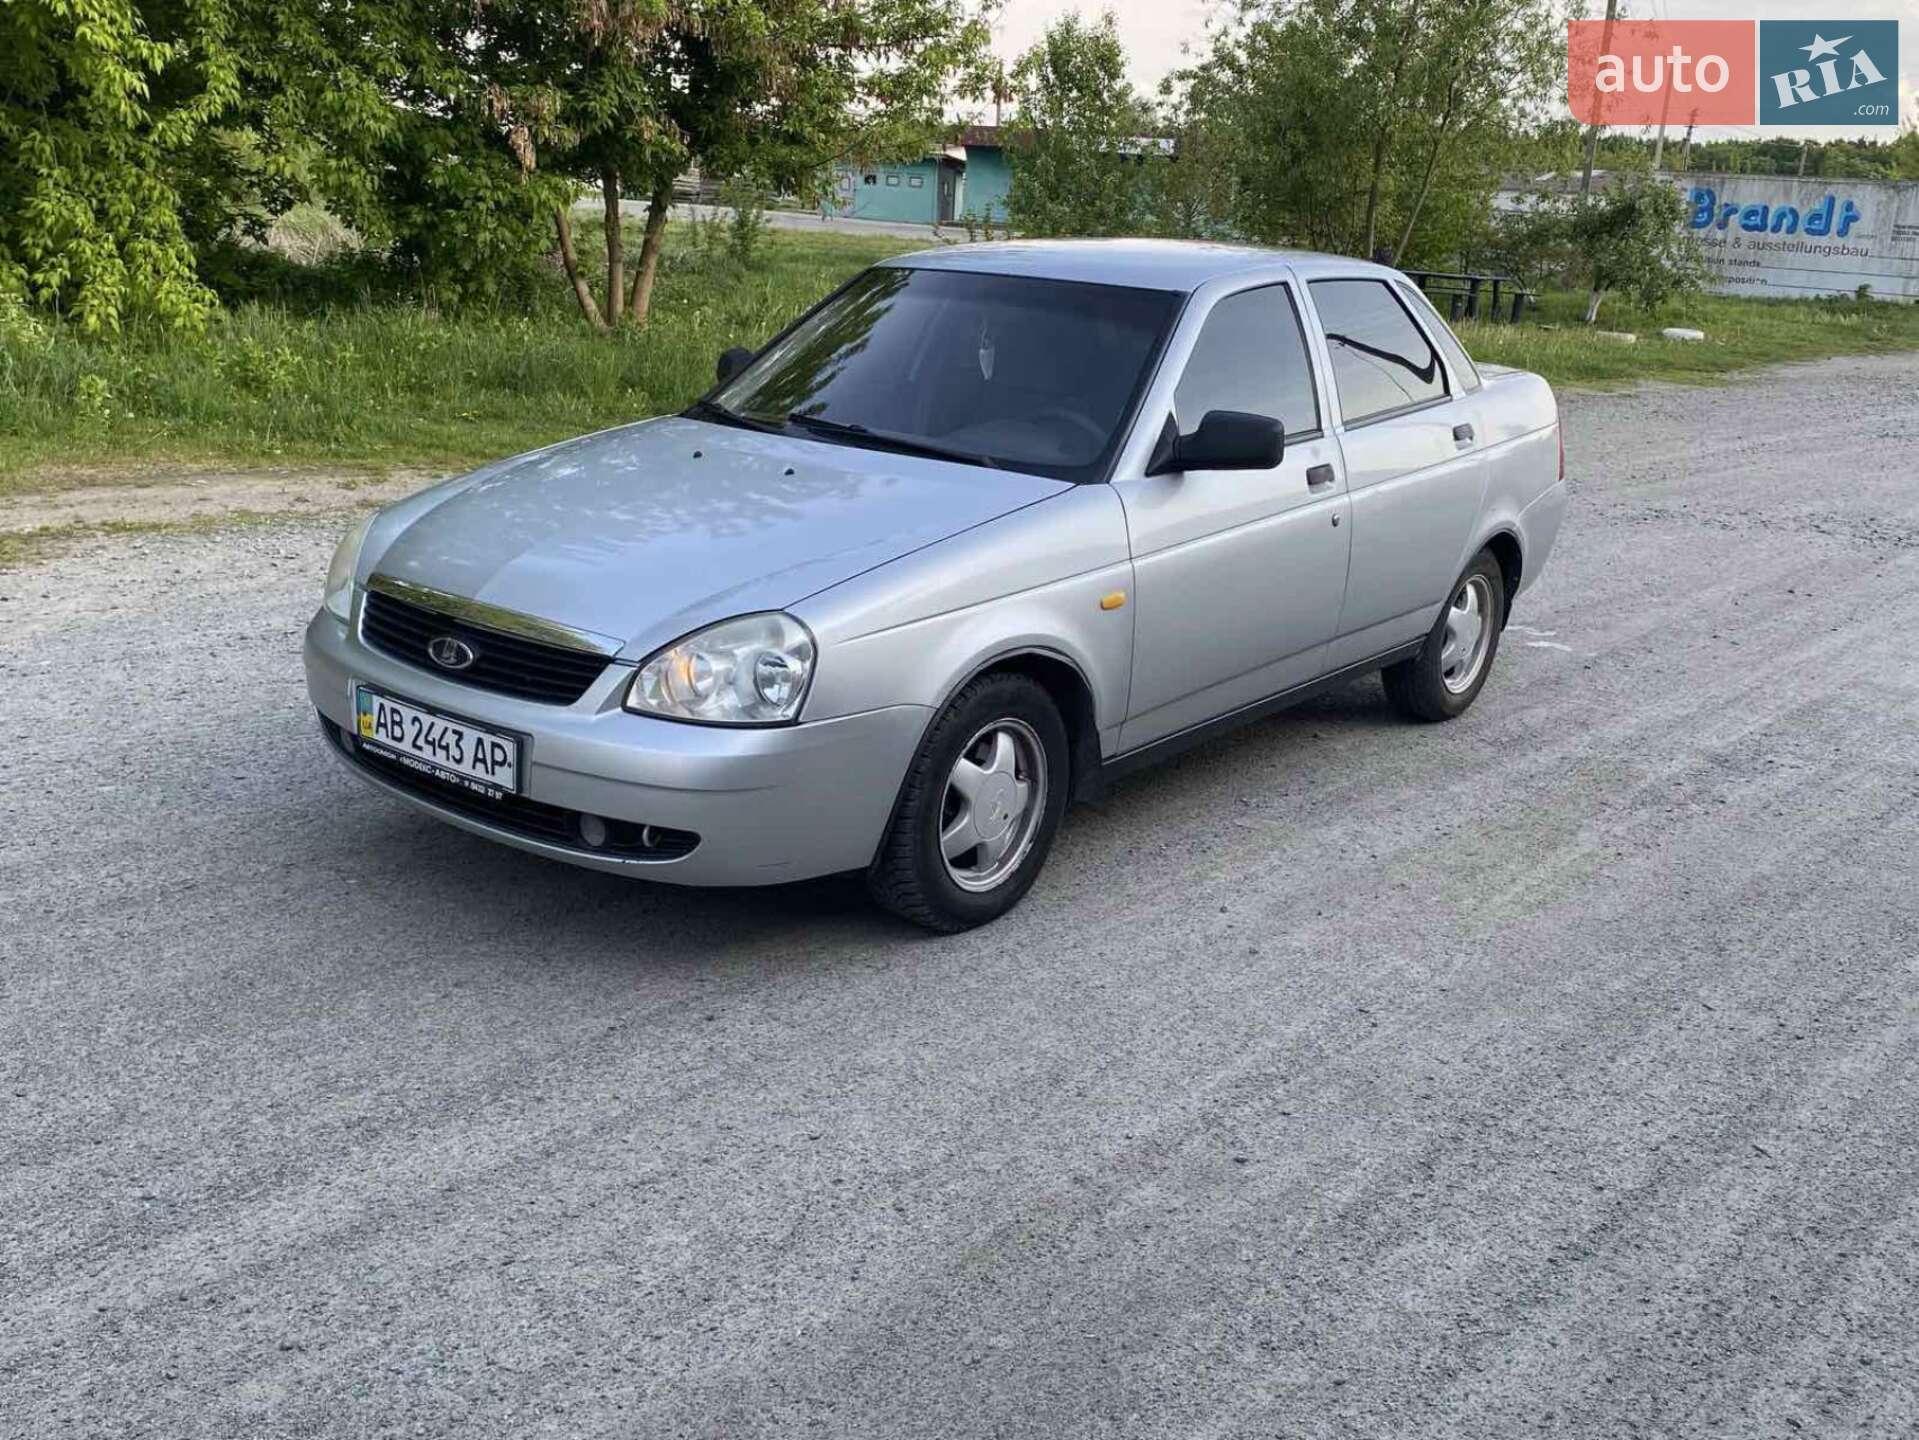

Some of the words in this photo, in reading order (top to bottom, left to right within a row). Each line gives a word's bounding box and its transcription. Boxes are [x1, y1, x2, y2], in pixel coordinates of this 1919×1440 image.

[1688, 187, 1861, 238] Brandt
[1747, 239, 1869, 257] ausstellungsbau
[375, 702, 405, 743] AB
[411, 715, 464, 765] 2443
[472, 736, 508, 776] AP
